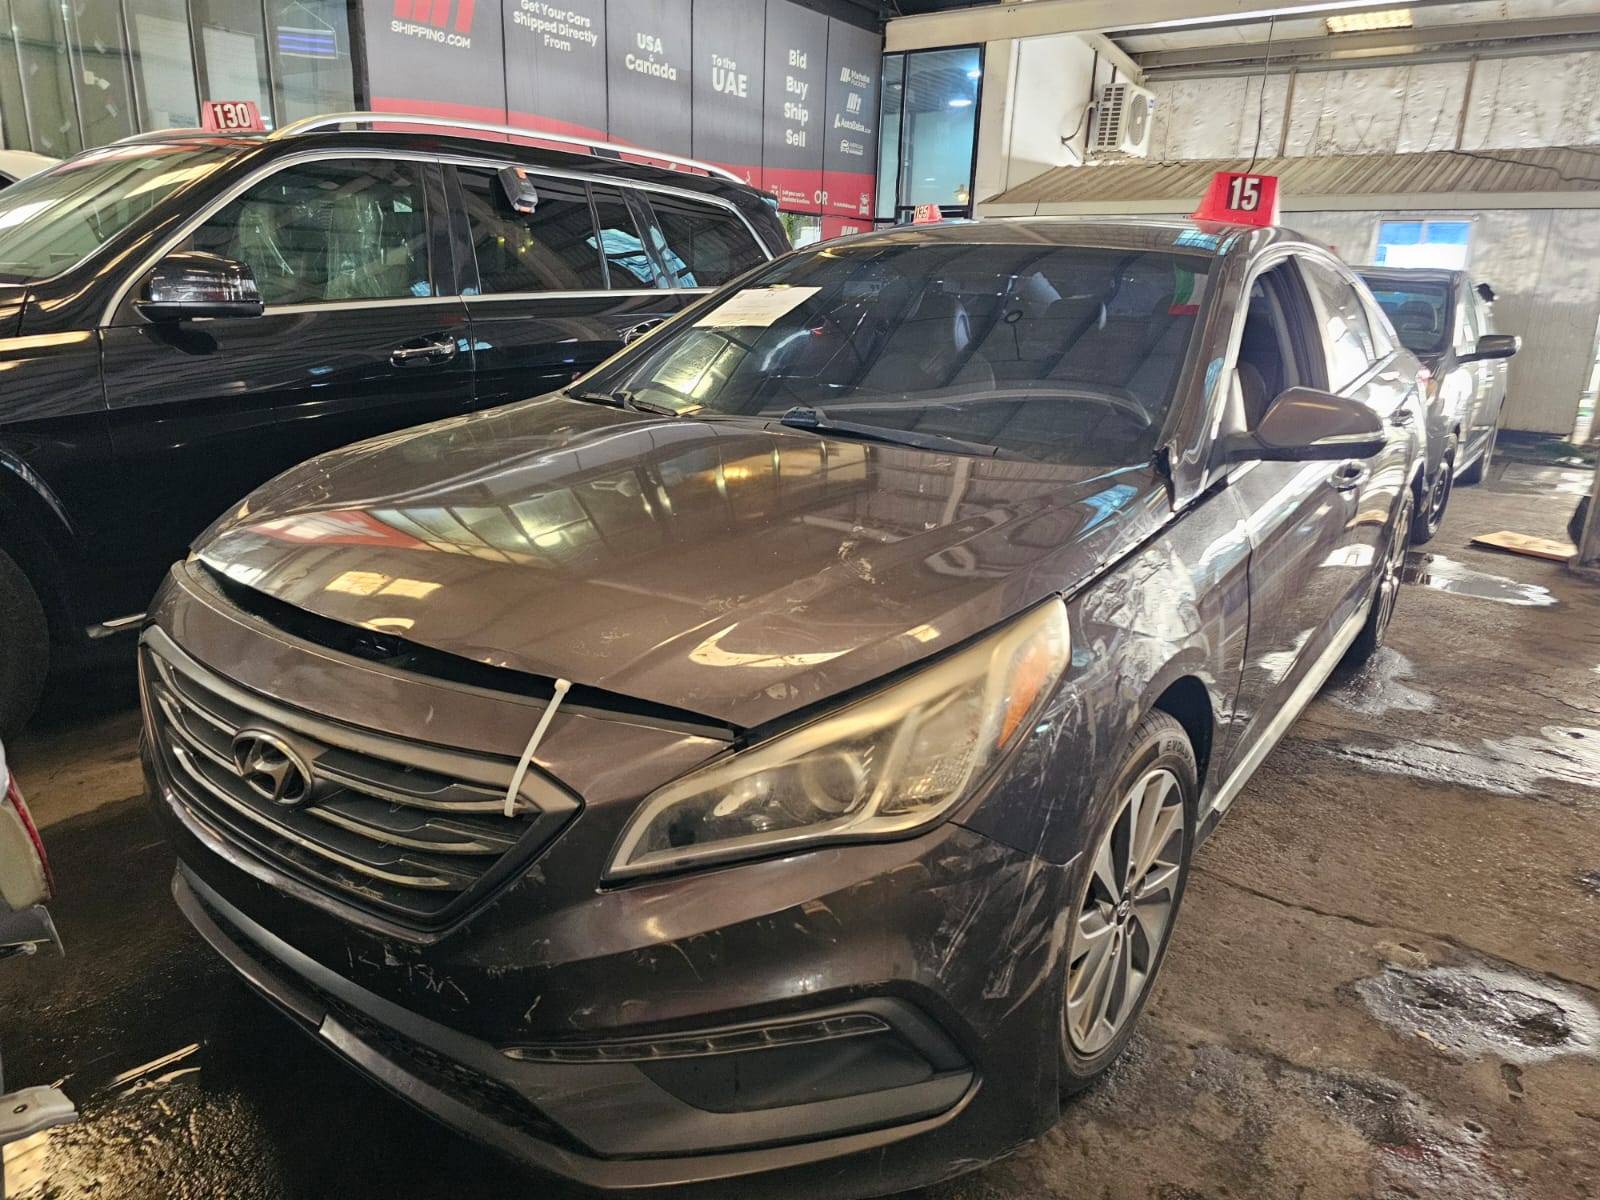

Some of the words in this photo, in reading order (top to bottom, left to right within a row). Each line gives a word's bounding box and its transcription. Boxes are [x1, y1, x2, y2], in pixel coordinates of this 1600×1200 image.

[521, 0, 540, 13] Get
[541, 3, 566, 21] Your
[567, 11, 591, 28] Cars
[391, 20, 471, 48] SHIPPING.COM
[513, 11, 557, 34] Shipped
[559, 23, 598, 47] Directly
[544, 34, 571, 52] From
[637, 32, 663, 54] USA
[625, 53, 676, 80] Canada
[712, 54, 722, 66] To
[723, 57, 736, 70] the
[789, 49, 807, 69] Bid
[712, 67, 747, 98] UAE
[786, 75, 808, 101] Buy
[214, 103, 251, 128] 130
[784, 102, 809, 126] Ship
[786, 129, 806, 147] Sell
[814, 190, 828, 205] OR
[1231, 176, 1260, 211] 15
